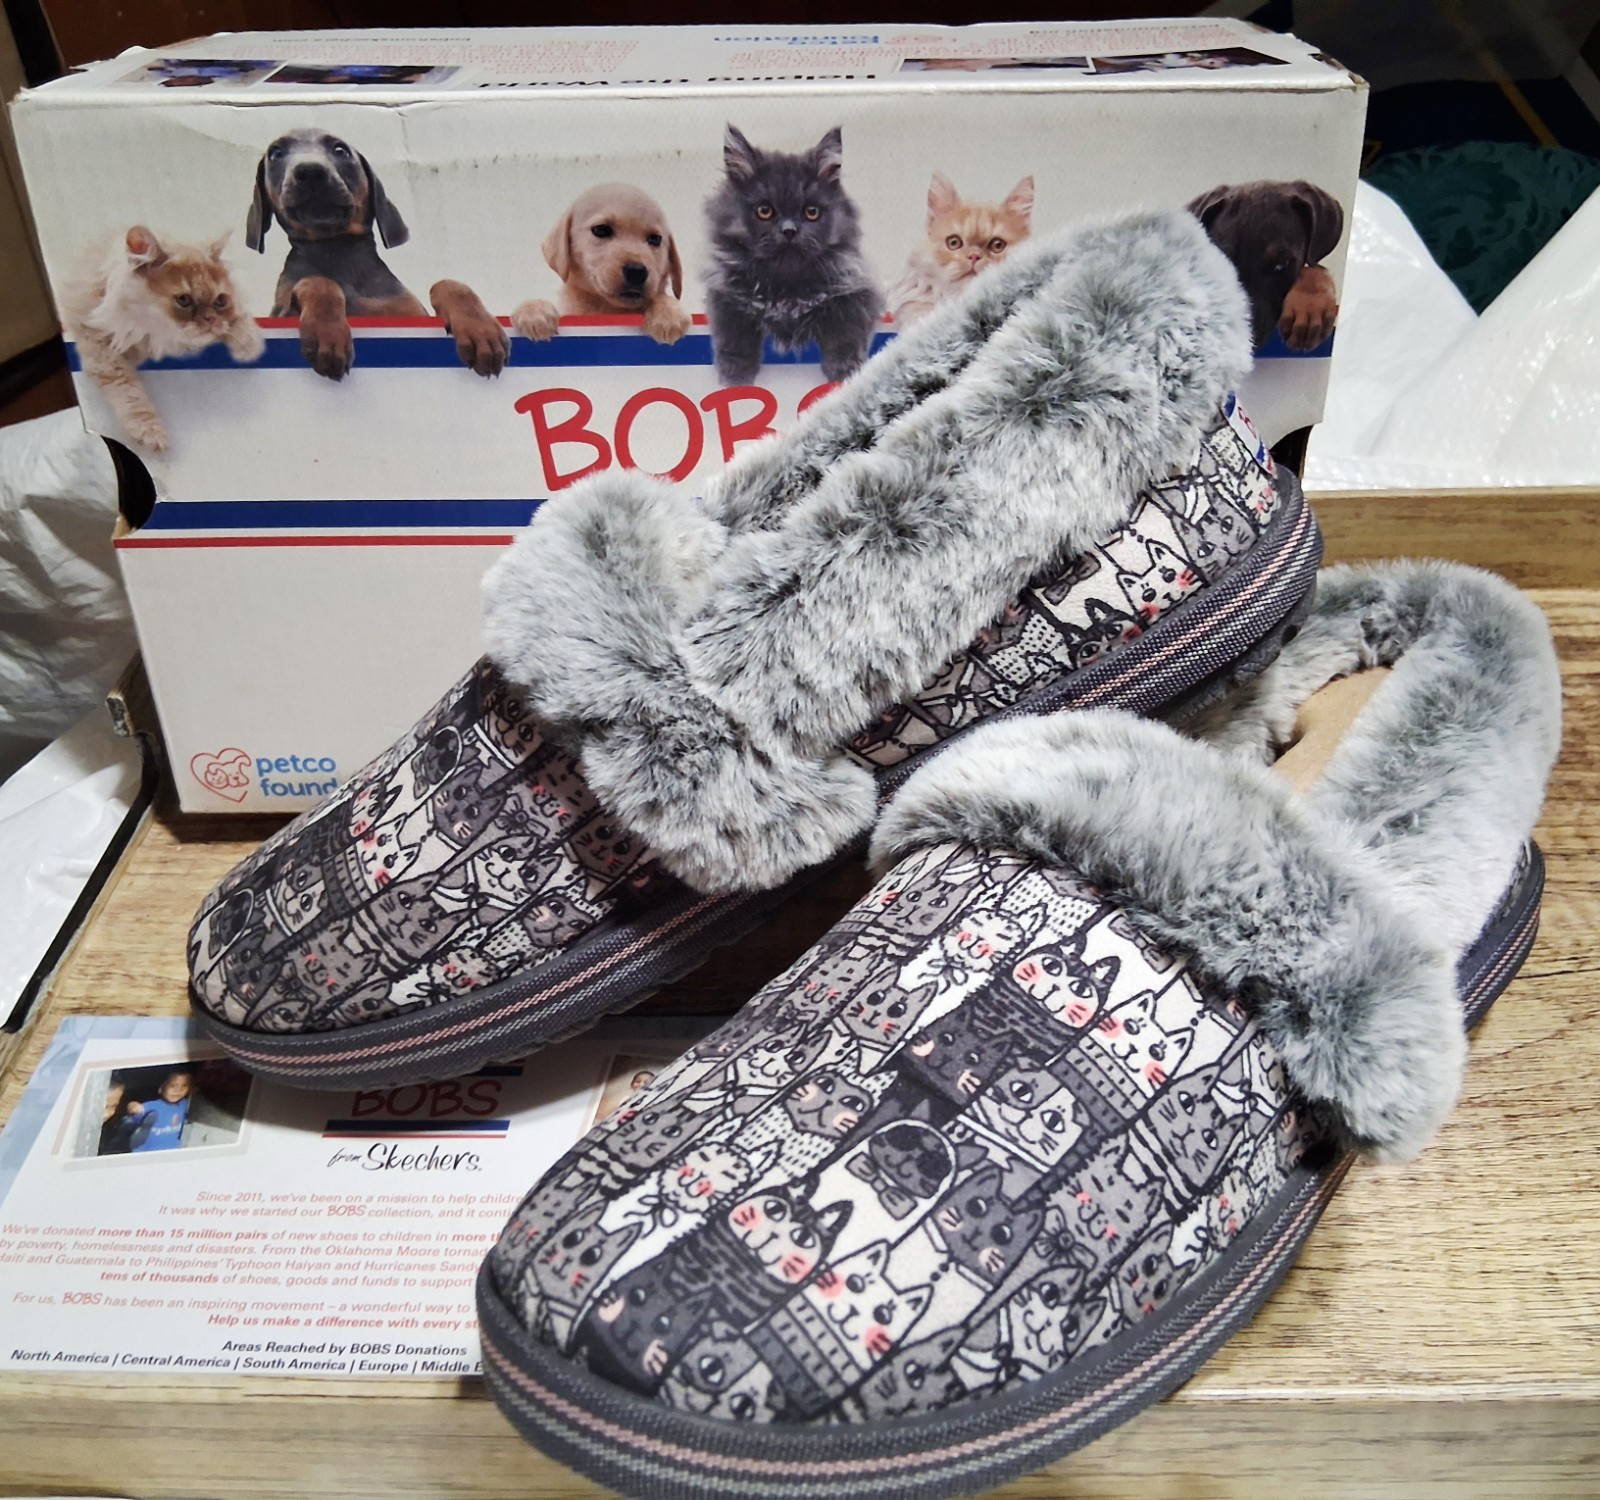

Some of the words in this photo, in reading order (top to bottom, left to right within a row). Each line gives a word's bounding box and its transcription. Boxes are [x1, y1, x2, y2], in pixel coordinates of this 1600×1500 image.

[514, 381, 844, 491] BOB
[256, 754, 336, 777] petco
[260, 778, 338, 797] found
[352, 1079, 503, 1117] BOBS
[327, 1148, 362, 1168] from
[196, 1191, 232, 1202] Since
[235, 1191, 265, 1205] 2011,
[270, 1192, 307, 1203] we've
[310, 1193, 341, 1203] been
[346, 1194, 362, 1203] on
[366, 1195, 374, 1203] a
[377, 1193, 428, 1204] mission
[432, 1194, 444, 1204] to
[448, 1194, 476, 1207] help
[159, 1205, 168, 1215] It
[171, 1207, 196, 1216] was
[200, 1206, 226, 1218] why
[230, 1207, 249, 1216] we
[252, 1206, 297, 1217] started
[300, 1208, 322, 1217] our
[327, 1205, 367, 1216] BOBS
[368, 1207, 435, 1219] collection,
[438, 1207, 463, 1218] and
[466, 1207, 475, 1218] it
[3, 1224, 39, 1235] We've
[42, 1225, 95, 1237] donated
[98, 1229, 131, 1238] more
[135, 1229, 164, 1239] than
[170, 1229, 184, 1239] 15
[187, 1230, 232, 1240] million
[235, 1231, 268, 1242] pairs
[272, 1230, 287, 1241] of
[288, 1232, 317, 1241] new
[319, 1231, 358, 1242] shoes
[362, 1232, 376, 1242] to
[379, 1231, 433, 1243] children
[435, 1232, 448, 1242] in
[452, 1233, 487, 1243] more
[0, 1238, 15, 1249] by
[17, 1240, 68, 1251] poverty,
[72, 1241, 164, 1253] homelessness
[167, 1244, 193, 1253] and
[196, 1245, 257, 1255] disasters.
[261, 1245, 296, 1255] From
[300, 1245, 321, 1256] the
[325, 1245, 392, 1257] Oklahoma
[397, 1246, 439, 1257] Moore
[27, 1255, 54, 1264] and
[55, 1255, 125, 1267] Guatemala
[129, 1257, 142, 1267] to
[225, 1259, 281, 1271] Typhoon
[285, 1260, 331, 1273] Haiyan
[335, 1261, 360, 1271] and
[363, 1261, 435, 1272] Hurricanes
[101, 1272, 129, 1281] tens
[132, 1272, 147, 1281] of
[150, 1272, 219, 1284] thousands
[222, 1274, 237, 1284] of
[239, 1275, 282, 1286] shoes,
[286, 1276, 328, 1288] goods
[331, 1276, 357, 1287] and
[361, 1276, 399, 1287] funds
[403, 1277, 416, 1287] to
[420, 1277, 472, 1289] support
[13, 1292, 36, 1303] For
[38, 1294, 56, 1304] us,
[62, 1292, 102, 1304] BOBS
[104, 1294, 127, 1306] has
[131, 1297, 164, 1307] been
[168, 1299, 184, 1308] an
[187, 1299, 247, 1312] inspiring
[250, 1302, 324, 1312] movement
[338, 1303, 347, 1312] a
[351, 1301, 421, 1313] wonderful
[425, 1303, 452, 1315] way
[456, 1303, 470, 1313] to
[207, 1315, 238, 1327] Help
[243, 1317, 258, 1326] us
[262, 1317, 300, 1327] make
[304, 1319, 311, 1327] a
[316, 1316, 383, 1328] difference
[388, 1317, 418, 1328] with
[422, 1319, 461, 1332] every
[222, 1340, 261, 1351] Areas
[265, 1342, 325, 1354] Reached
[328, 1343, 346, 1357] by
[350, 1343, 391, 1355] BOBS
[394, 1344, 467, 1356] Donations
[10, 1350, 50, 1361] North
[53, 1351, 109, 1364] America
[121, 1353, 171, 1365] Central
[173, 1355, 230, 1368] America
[242, 1358, 285, 1370] South
[288, 1359, 345, 1371] America
[358, 1360, 409, 1373] Europe
[420, 1361, 470, 1372] Middle
